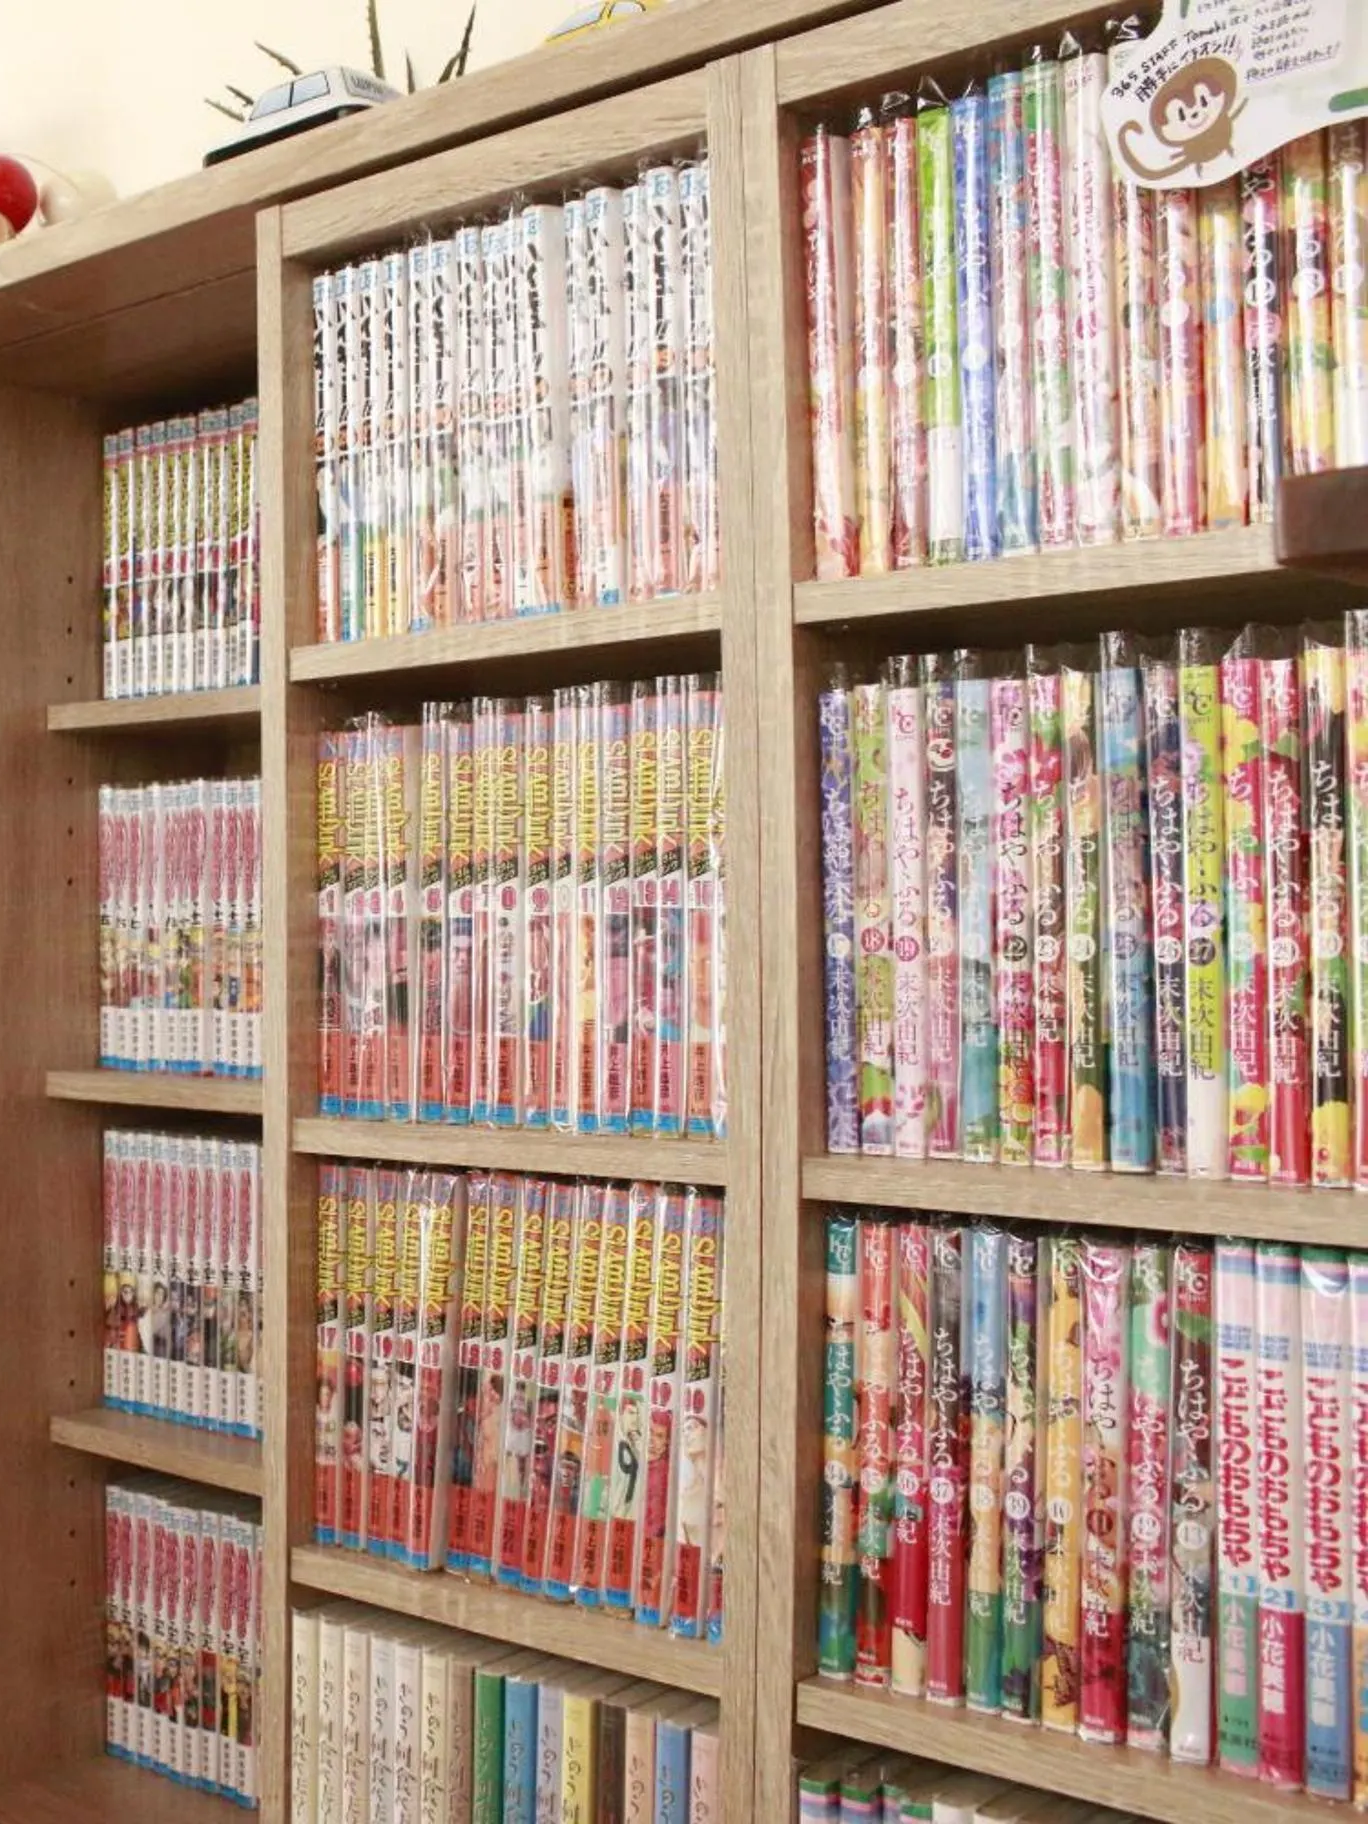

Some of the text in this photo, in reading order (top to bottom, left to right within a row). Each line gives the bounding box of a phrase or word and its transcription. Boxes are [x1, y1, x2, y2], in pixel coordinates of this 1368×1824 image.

[1112, 74, 1138, 98] 365
[932, 1327, 959, 1469] ちはやふる
